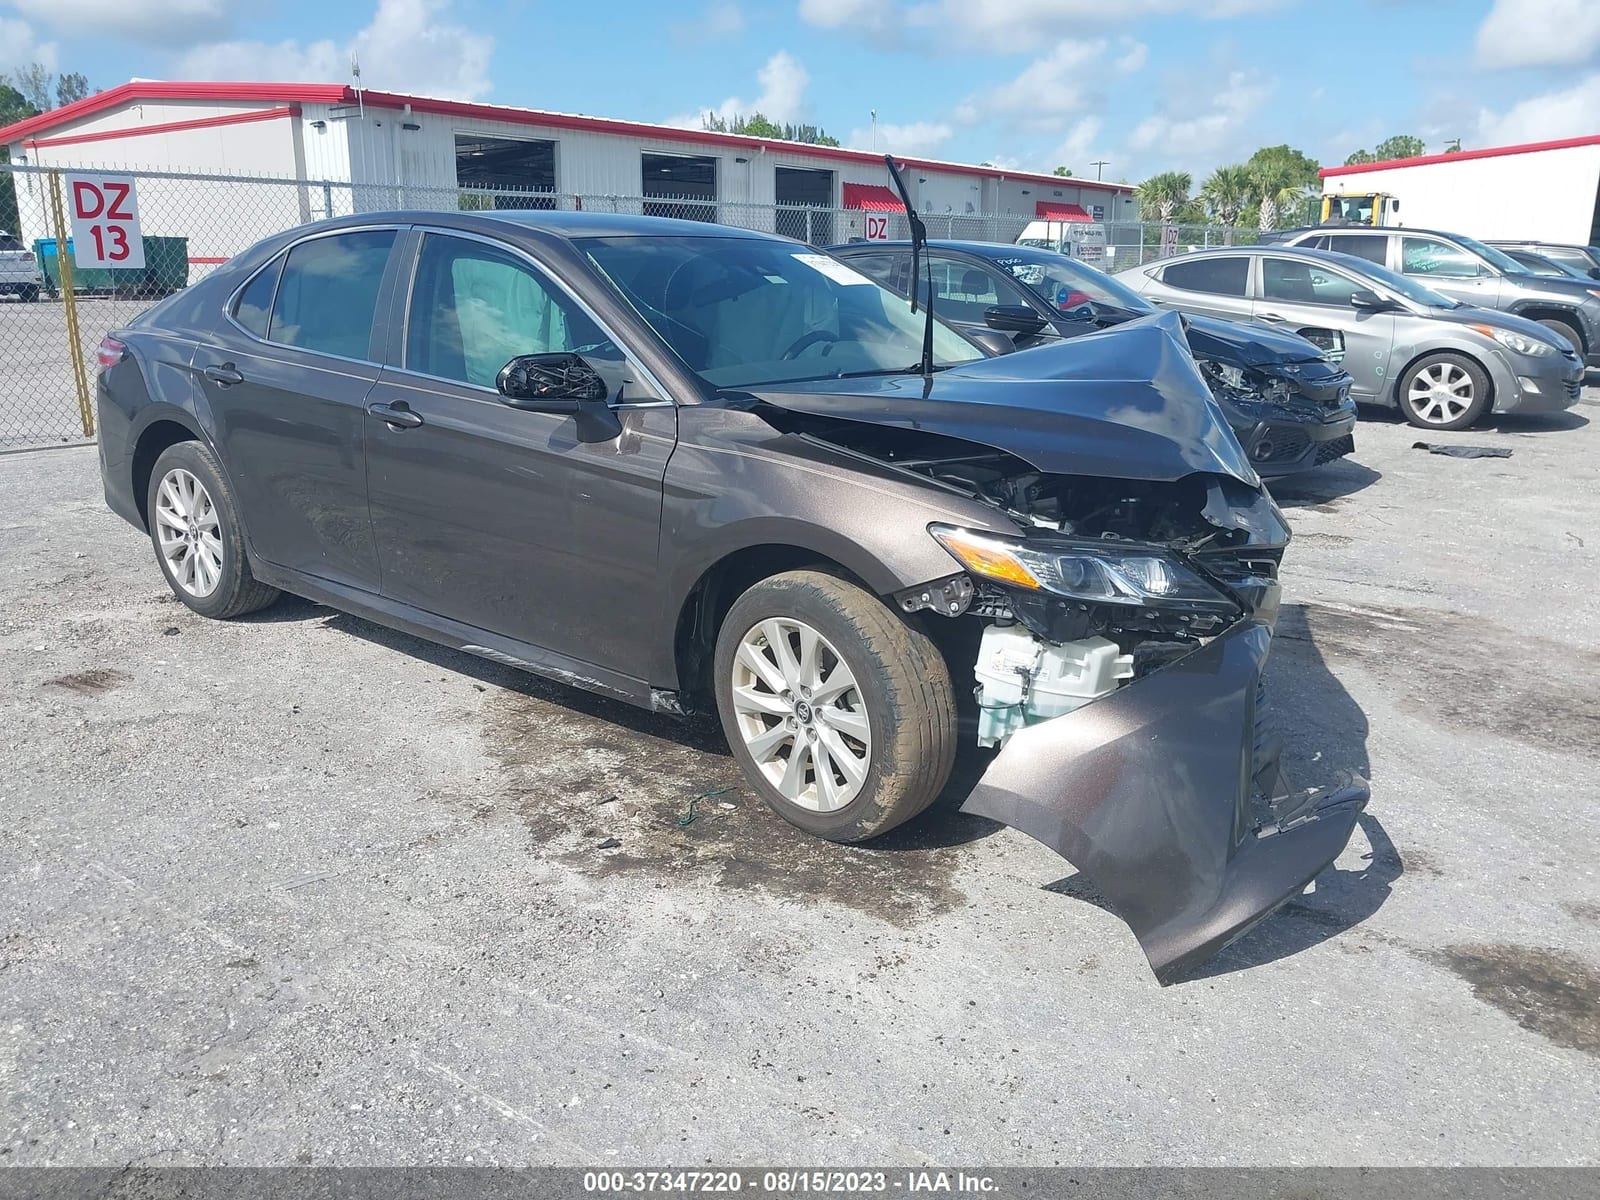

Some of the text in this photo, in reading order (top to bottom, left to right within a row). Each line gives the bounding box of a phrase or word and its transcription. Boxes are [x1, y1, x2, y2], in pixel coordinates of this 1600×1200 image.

[73, 182, 133, 220] DZ
[868, 217, 887, 239] DZ
[1168, 230, 1178, 244] DZ
[90, 225, 130, 261] 13
